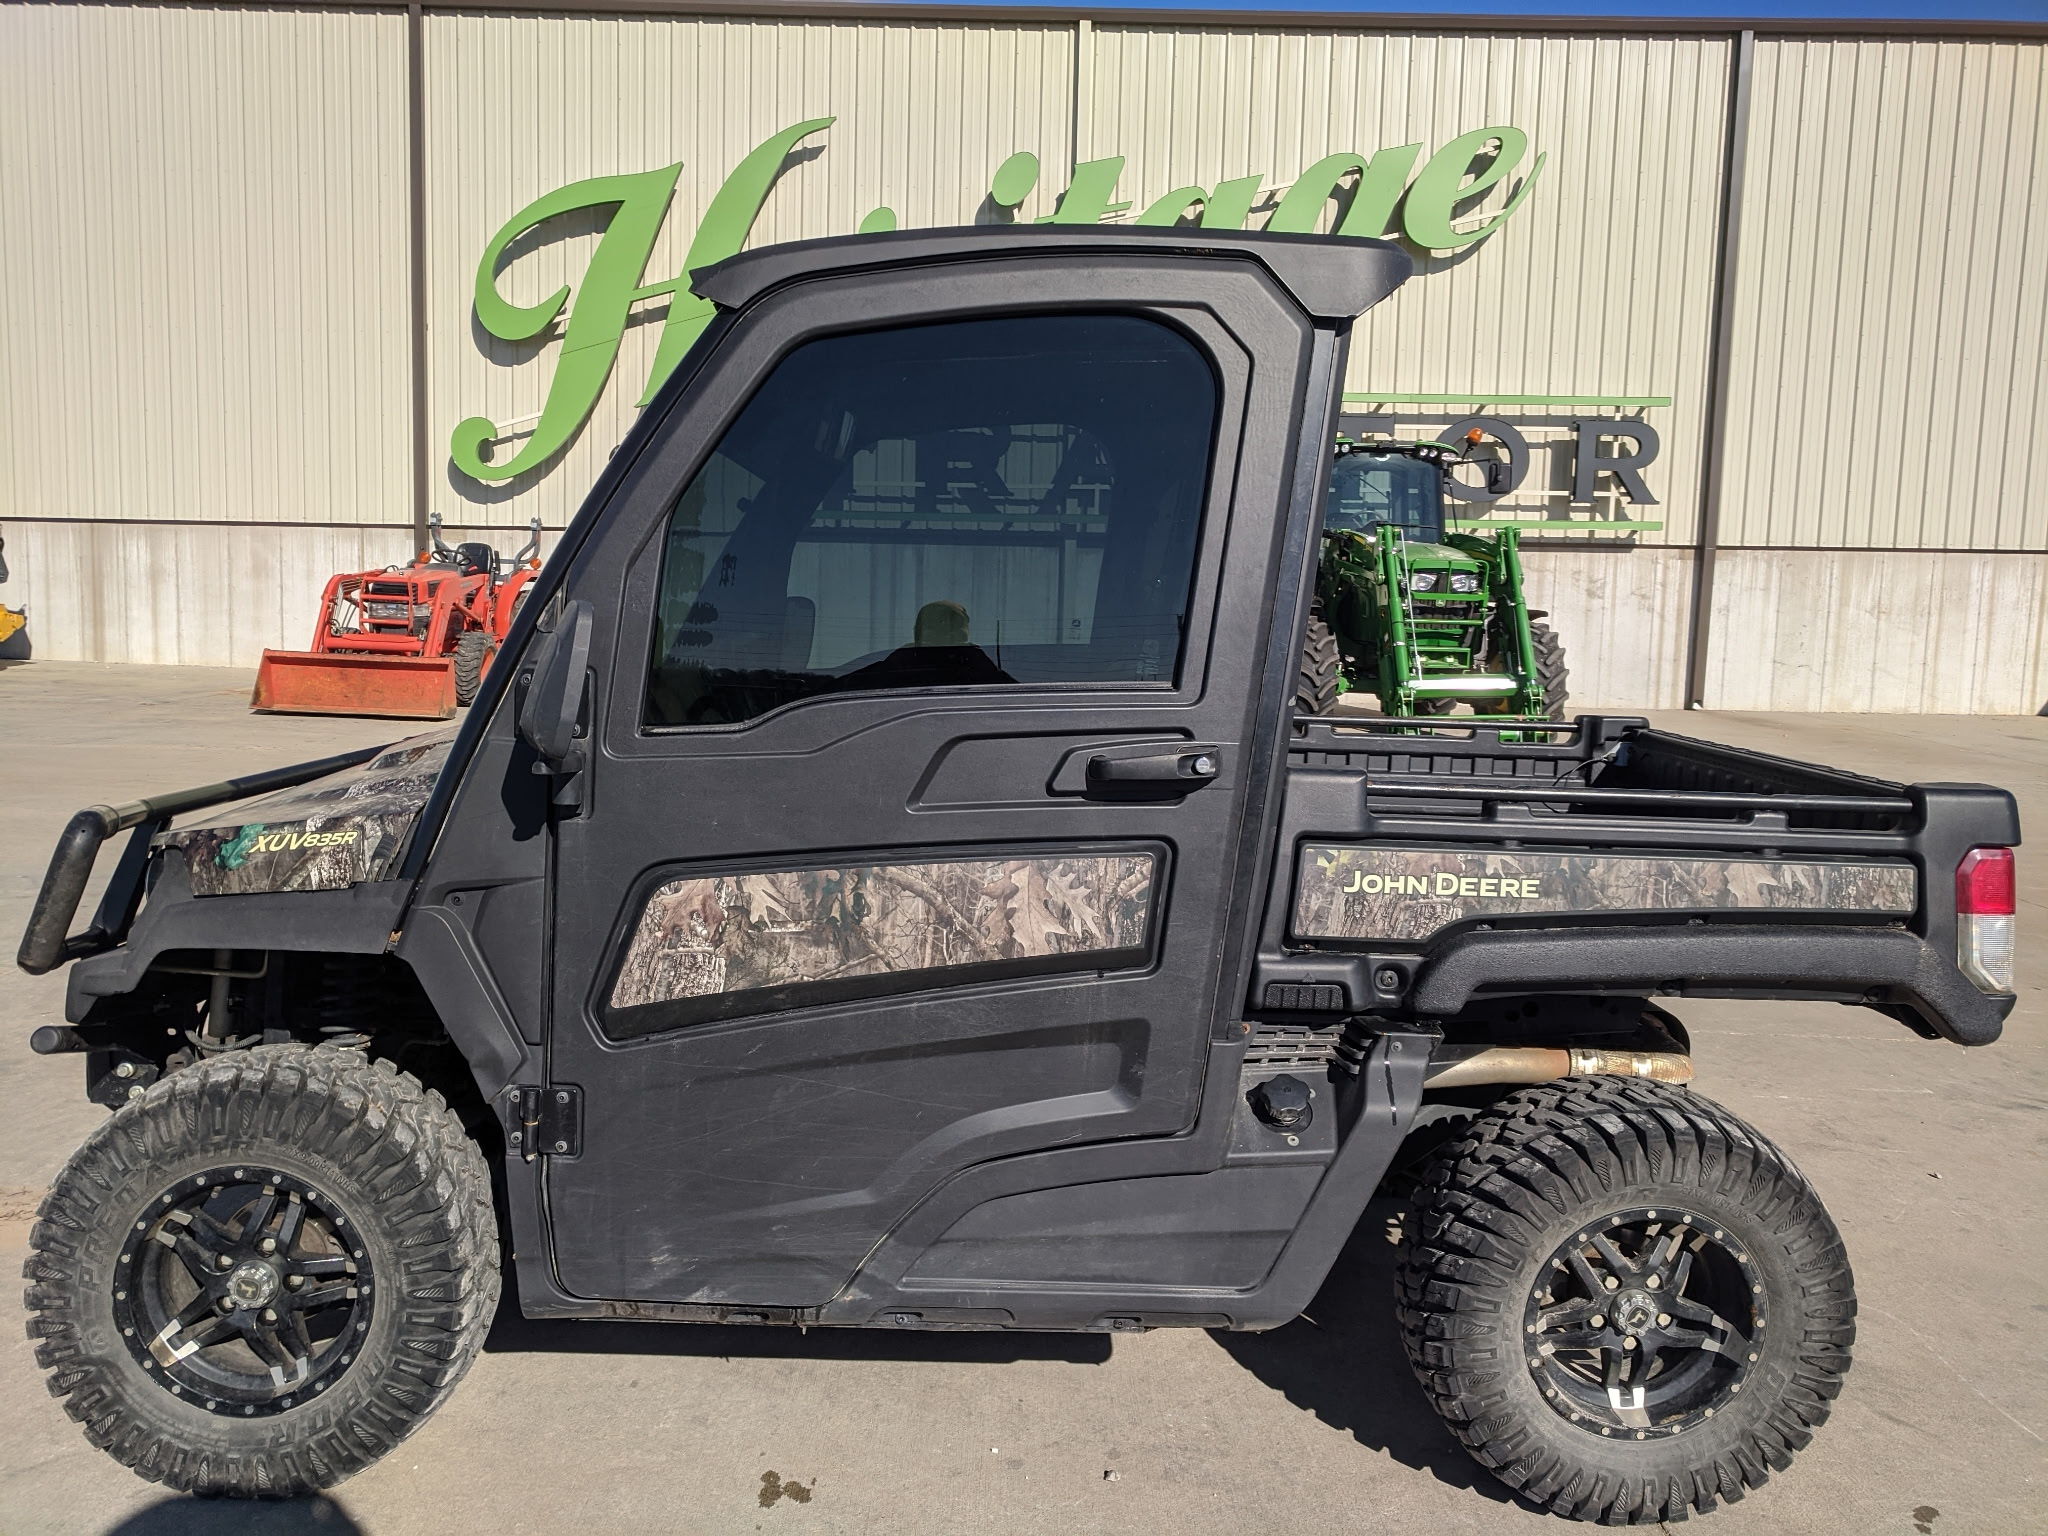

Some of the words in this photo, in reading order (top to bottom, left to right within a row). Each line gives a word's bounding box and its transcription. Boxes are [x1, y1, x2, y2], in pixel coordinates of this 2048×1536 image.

[248, 830, 359, 854] XUV835R
[1343, 870, 1428, 897] JOHN
[1435, 872, 1540, 899] DEERE
